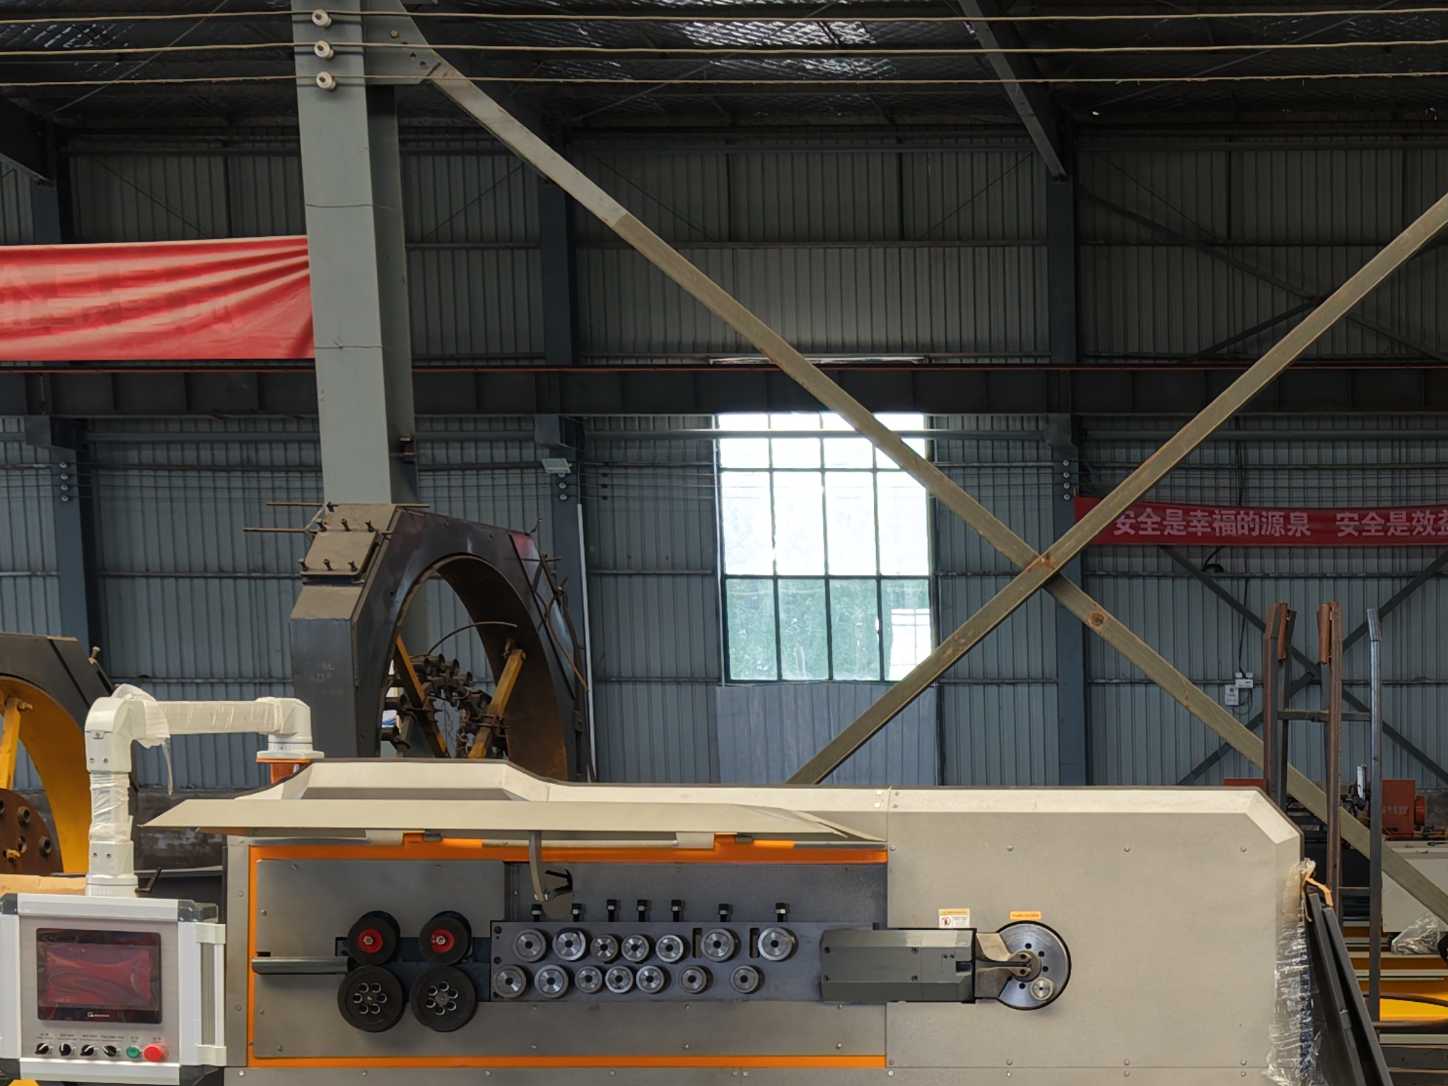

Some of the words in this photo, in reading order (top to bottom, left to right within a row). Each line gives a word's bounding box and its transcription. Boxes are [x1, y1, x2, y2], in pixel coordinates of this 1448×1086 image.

[1113, 508, 1311, 537] 安全是幸福的源泉
